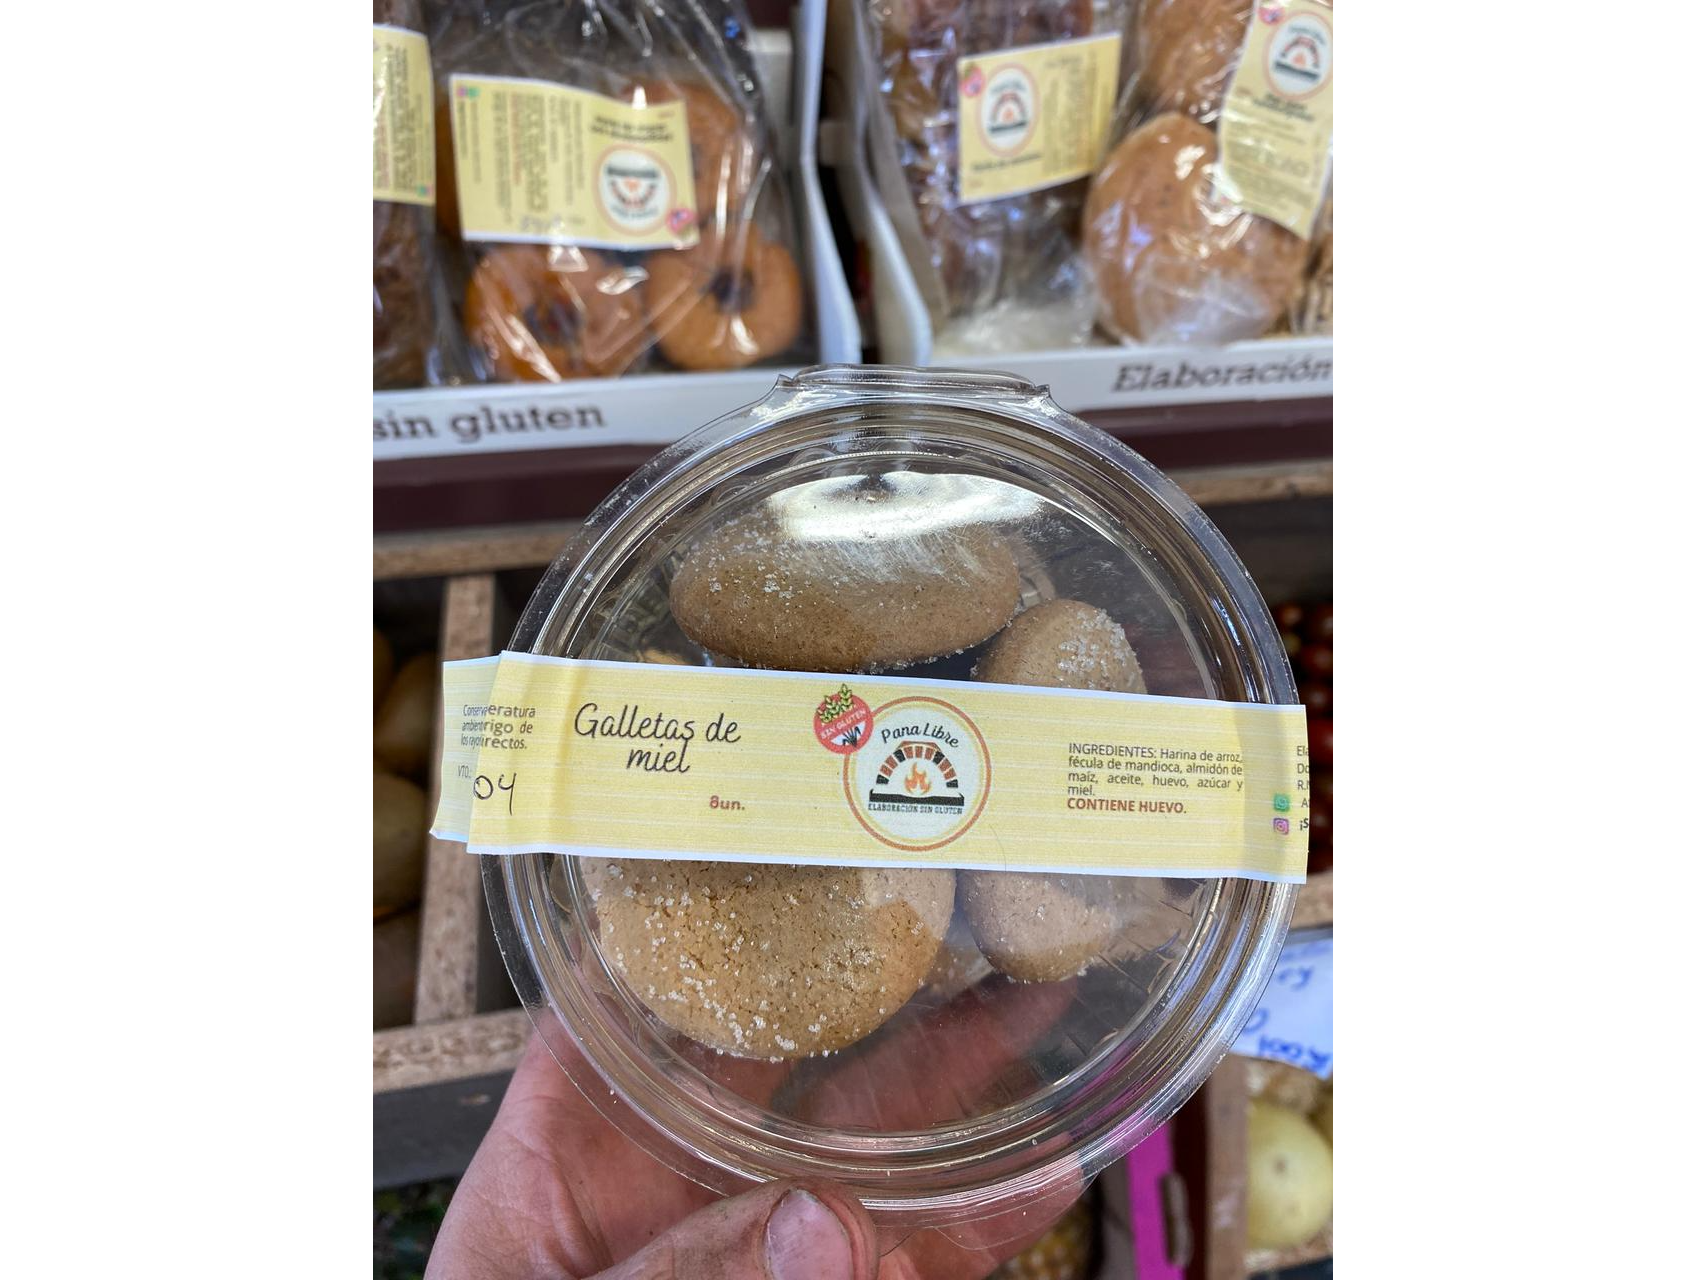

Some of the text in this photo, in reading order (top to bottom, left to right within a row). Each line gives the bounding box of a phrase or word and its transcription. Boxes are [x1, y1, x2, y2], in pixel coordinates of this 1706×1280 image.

[1111, 358, 1333, 392] Elaboración
[373, 403, 605, 443] sin gluten
[520, 721, 534, 734] de
[574, 702, 741, 743] Galletas de
[881, 722, 959, 748] Pana Libre
[626, 739, 690, 773] miel
[1068, 743, 1157, 759] INGREDIENTES:
[1160, 748, 1197, 760] Harina
[1199, 749, 1213, 761] de
[1068, 755, 1243, 775] fécula de mandioca, almidón de
[1067, 784, 1095, 796] miel.
[1068, 770, 1243, 792] maíz, aceite, huevo, azúcar y
[709, 795, 745, 811] 8un.
[1067, 797, 1187, 814] CONTIENE HUEVO.
